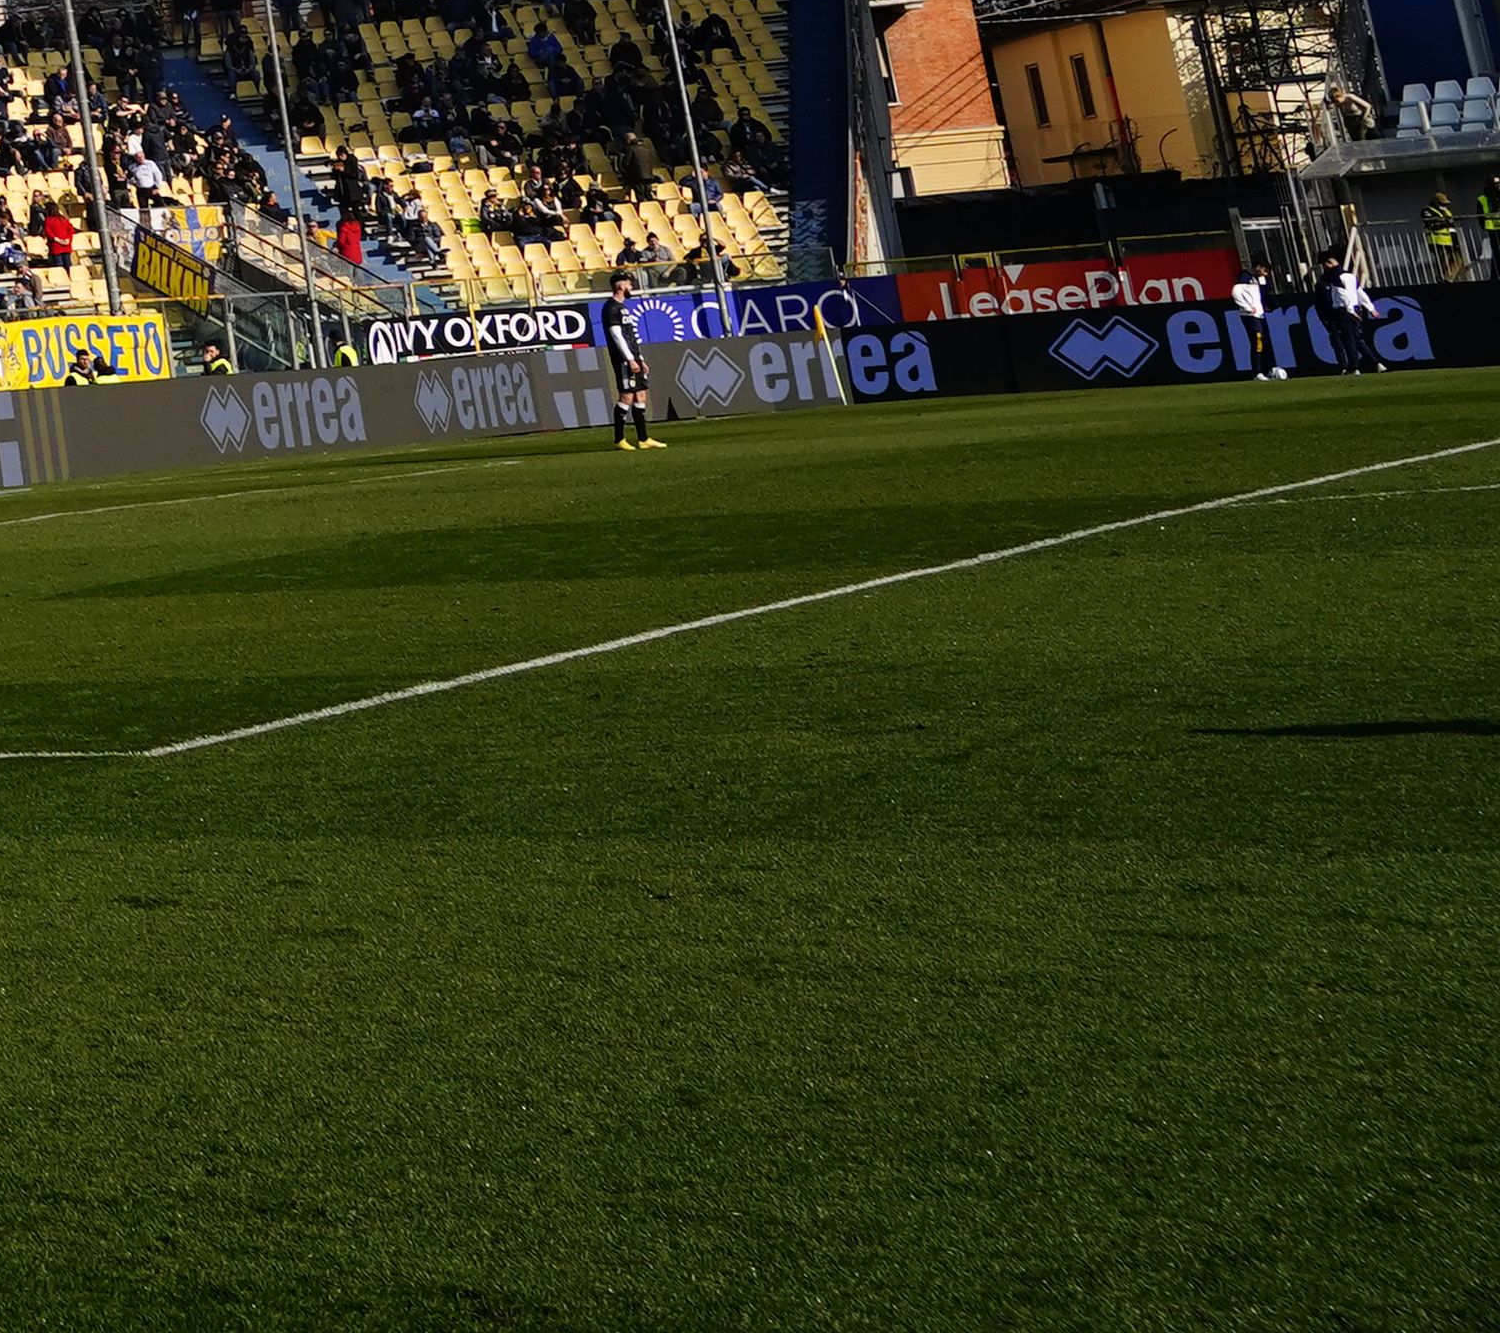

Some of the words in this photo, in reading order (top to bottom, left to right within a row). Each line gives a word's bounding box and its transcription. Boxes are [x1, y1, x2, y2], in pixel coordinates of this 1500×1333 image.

[940, 271, 1205, 320] LeasePlan
[21, 321, 164, 382] BUSSETO
[443, 309, 587, 349] OXFORD
